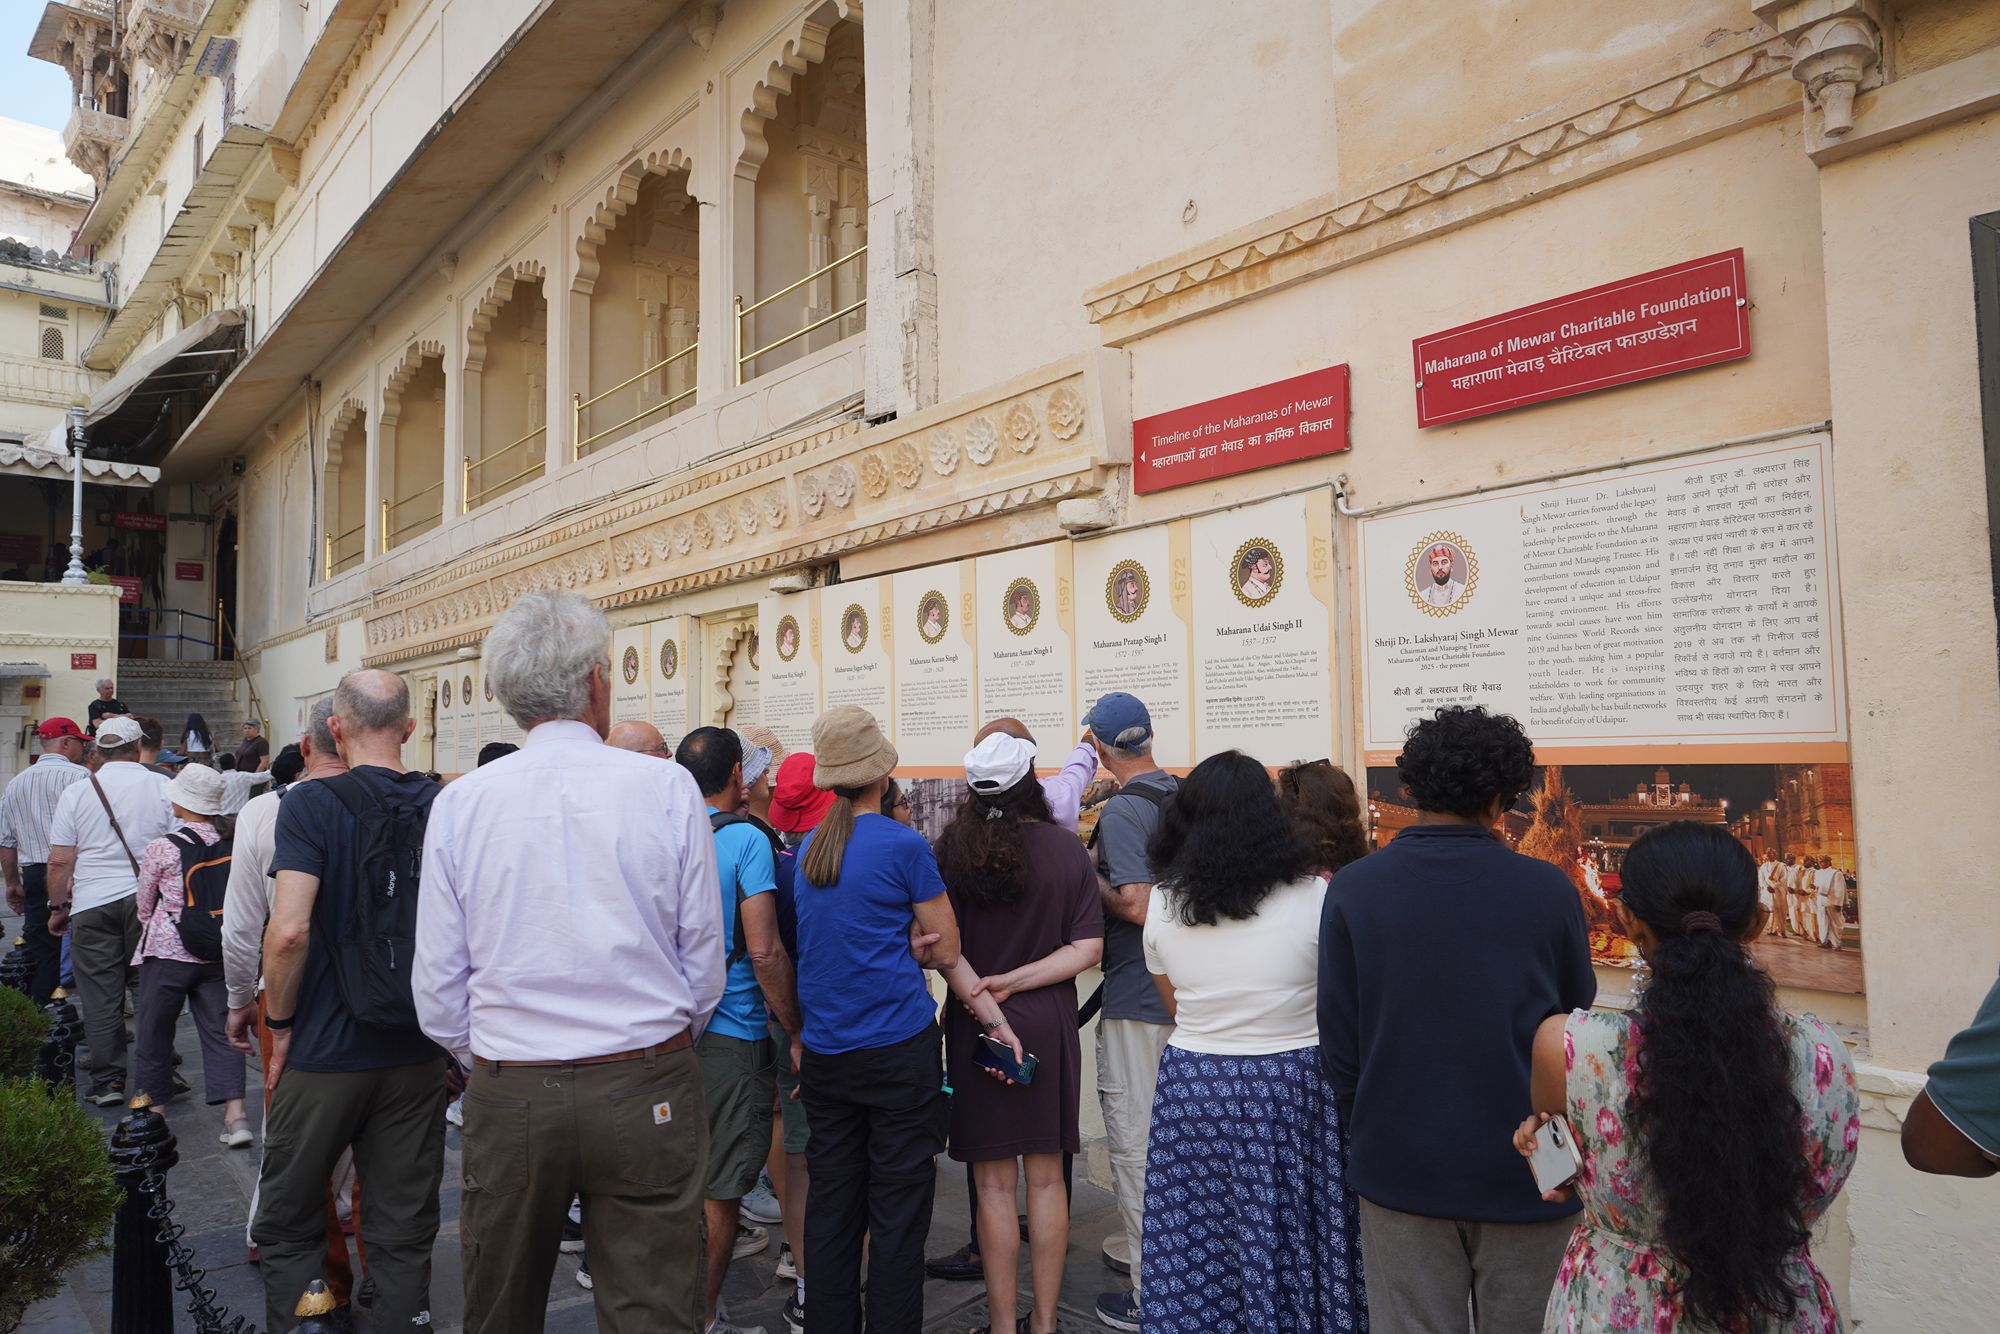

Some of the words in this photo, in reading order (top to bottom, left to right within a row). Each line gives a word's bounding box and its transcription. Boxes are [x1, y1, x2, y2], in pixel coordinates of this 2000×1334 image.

[1425, 350, 1487, 374] Maharana
[1491, 342, 1504, 357] of
[1507, 329, 1555, 353] Mewar
[1561, 310, 1635, 339] Charitable
[1641, 285, 1731, 319] Foundation
[1451, 368, 1502, 390] महाराणा
[1506, 358, 1543, 374] मेवाड़
[1548, 340, 1611, 365] चैरिटेबल
[1616, 318, 1697, 348] फाउण्डेशन
[1152, 431, 1190, 447] Timeline
[1193, 425, 1202, 438] of
[1205, 422, 1220, 435] the
[1224, 410, 1278, 430] Maharanas
[1281, 403, 1291, 416] of
[1295, 395, 1333, 414] Mewar
[1152, 448, 1195, 468] महाराणाओं
[1199, 444, 1217, 460] द्वारा
[1222, 438, 1244, 452] मेवाड़
[1248, 435, 1260, 446] का
[1266, 427, 1294, 444] क्रमिक
[1300, 417, 1333, 435] विकास
[1684, 474, 1704, 486] श्रीजी
[1710, 472, 1728, 485] हुजूर
[1734, 468, 1746, 478] डॉ.
[1752, 463, 1786, 476] लक्ष्यराज
[1793, 458, 1811, 469] सिंह
[1540, 500, 1560, 510] Shriji
[1566, 496, 1590, 506] Huzur
[1596, 492, 1609, 501] Dr.
[1616, 484, 1656, 498] Lakshyaraj
[1666, 493, 1686, 504] मेवाड़
[1691, 488, 1711, 499] अपने
[1746, 481, 1757, 491] की
[1762, 478, 1789, 489] धरोहर
[1795, 473, 1812, 484] और
[1522, 514, 1541, 525] Singh
[1542, 512, 1566, 521] Mewar
[1567, 508, 1590, 518] carries
[1591, 501, 1619, 514] forward
[1620, 500, 1633, 510] the
[1634, 497, 1657, 509] legacy
[1666, 508, 1687, 518] मेवाड़
[1692, 504, 1701, 514] के
[1705, 501, 1732, 512] शाश्वत
[1764, 495, 1776, 504] का
[1667, 521, 1698, 533] महाराणा
[1699, 518, 1721, 528] मेवाड़
[1722, 513, 1756, 525] चैरिटेबल
[1757, 507, 1802, 520] फाउण्डेशन
[1803, 503, 1813, 514] के
[1522, 526, 1531, 536] of
[1535, 526, 1547, 534] his
[1552, 520, 1600, 534] predecessors,
[1606, 511, 1638, 524] through
[1644, 509, 1658, 518] the
[1522, 536, 1557, 548] leadership
[1557, 535, 1567, 543] he
[1567, 530, 1597, 544] provides
[1607, 527, 1620, 537] the
[1620, 524, 1658, 534] Maharana
[1523, 550, 1532, 560] of
[1532, 550, 1556, 559] Mewar
[1557, 543, 1594, 555] Charitable
[1595, 538, 1638, 550] Foundation
[1649, 535, 1661, 543] its
[1312, 536, 1327, 582] 1537
[1523, 562, 1558, 572] Chairman
[1559, 557, 1573, 567] and
[1575, 554, 1612, 565] Managing
[1612, 551, 1644, 560] Trustee.
[1645, 547, 1660, 557] His
[1524, 572, 1569, 584] contributions
[1573, 566, 1601, 577] towards
[1604, 563, 1641, 575] expansion
[1645, 559, 1661, 569] and
[1175, 558, 1186, 601] 1572
[1059, 577, 1070, 615] 1597
[963, 592, 972, 630] 1620
[1124, 638, 1143, 646] Pratap
[1144, 634, 1162, 645] Singh
[1164, 634, 1166, 642] I
[1216, 627, 1251, 636] Maharana
[1253, 623, 1270, 632] Udai
[1272, 620, 1293, 632] Singh
[1296, 619, 1302, 628] II
[1374, 637, 1396, 649] Shriji
[1398, 636, 1412, 646] Dr.
[1414, 632, 1458, 645] Lakshyaraj
[1460, 629, 1485, 642] Singh
[1487, 627, 1519, 638] Mewar
[1034, 646, 1048, 656] Singh
[1242, 638, 1256, 646] 1537
[1441, 652, 1471, 661] Charitable
[1472, 650, 1505, 658] Foundation
[1449, 662, 1470, 671] present
[1393, 686, 1411, 697] श्रीजी
[1414, 686, 1426, 696] डॉ.
[1429, 686, 1459, 695] लक्ष्यराज
[1462, 682, 1478, 693] सिंह
[1481, 681, 1502, 692] मेवाड़
